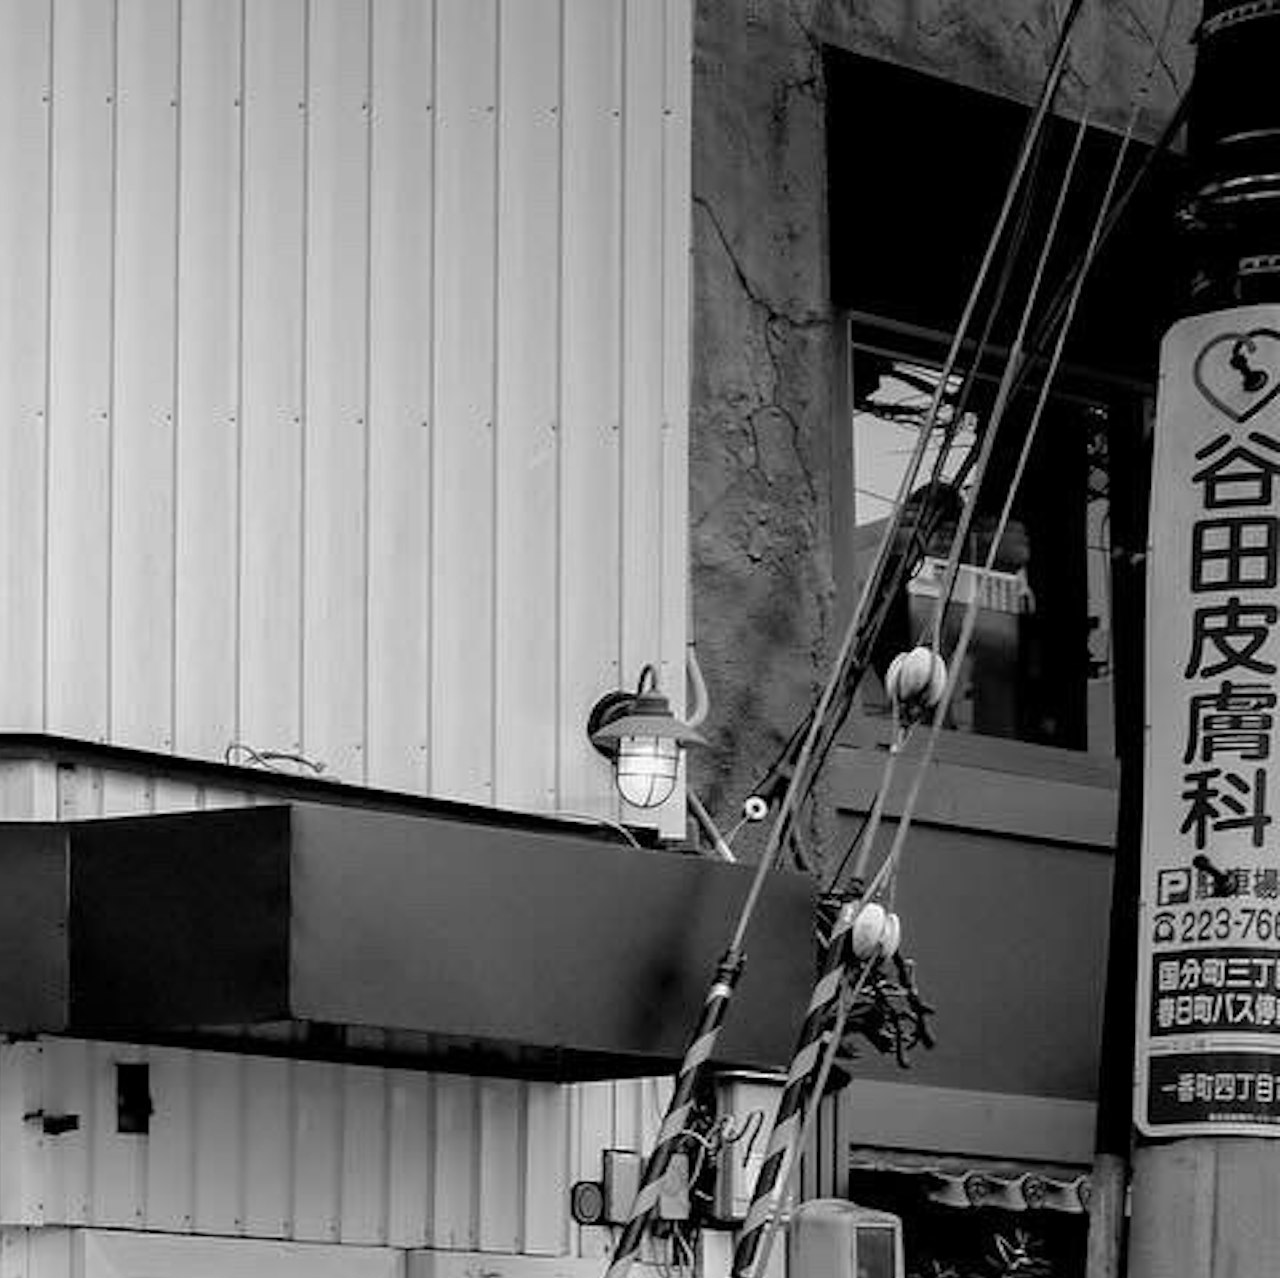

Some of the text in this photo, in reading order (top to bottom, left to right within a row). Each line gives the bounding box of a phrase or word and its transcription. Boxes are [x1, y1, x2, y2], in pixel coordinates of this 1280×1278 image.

[1179, 430, 1280, 849] 谷田皮膚科
[1181, 906, 1280, 941] 223-76
[1157, 957, 1280, 991] 国分町三丁
[1156, 993, 1280, 1028] 春日町バス停
